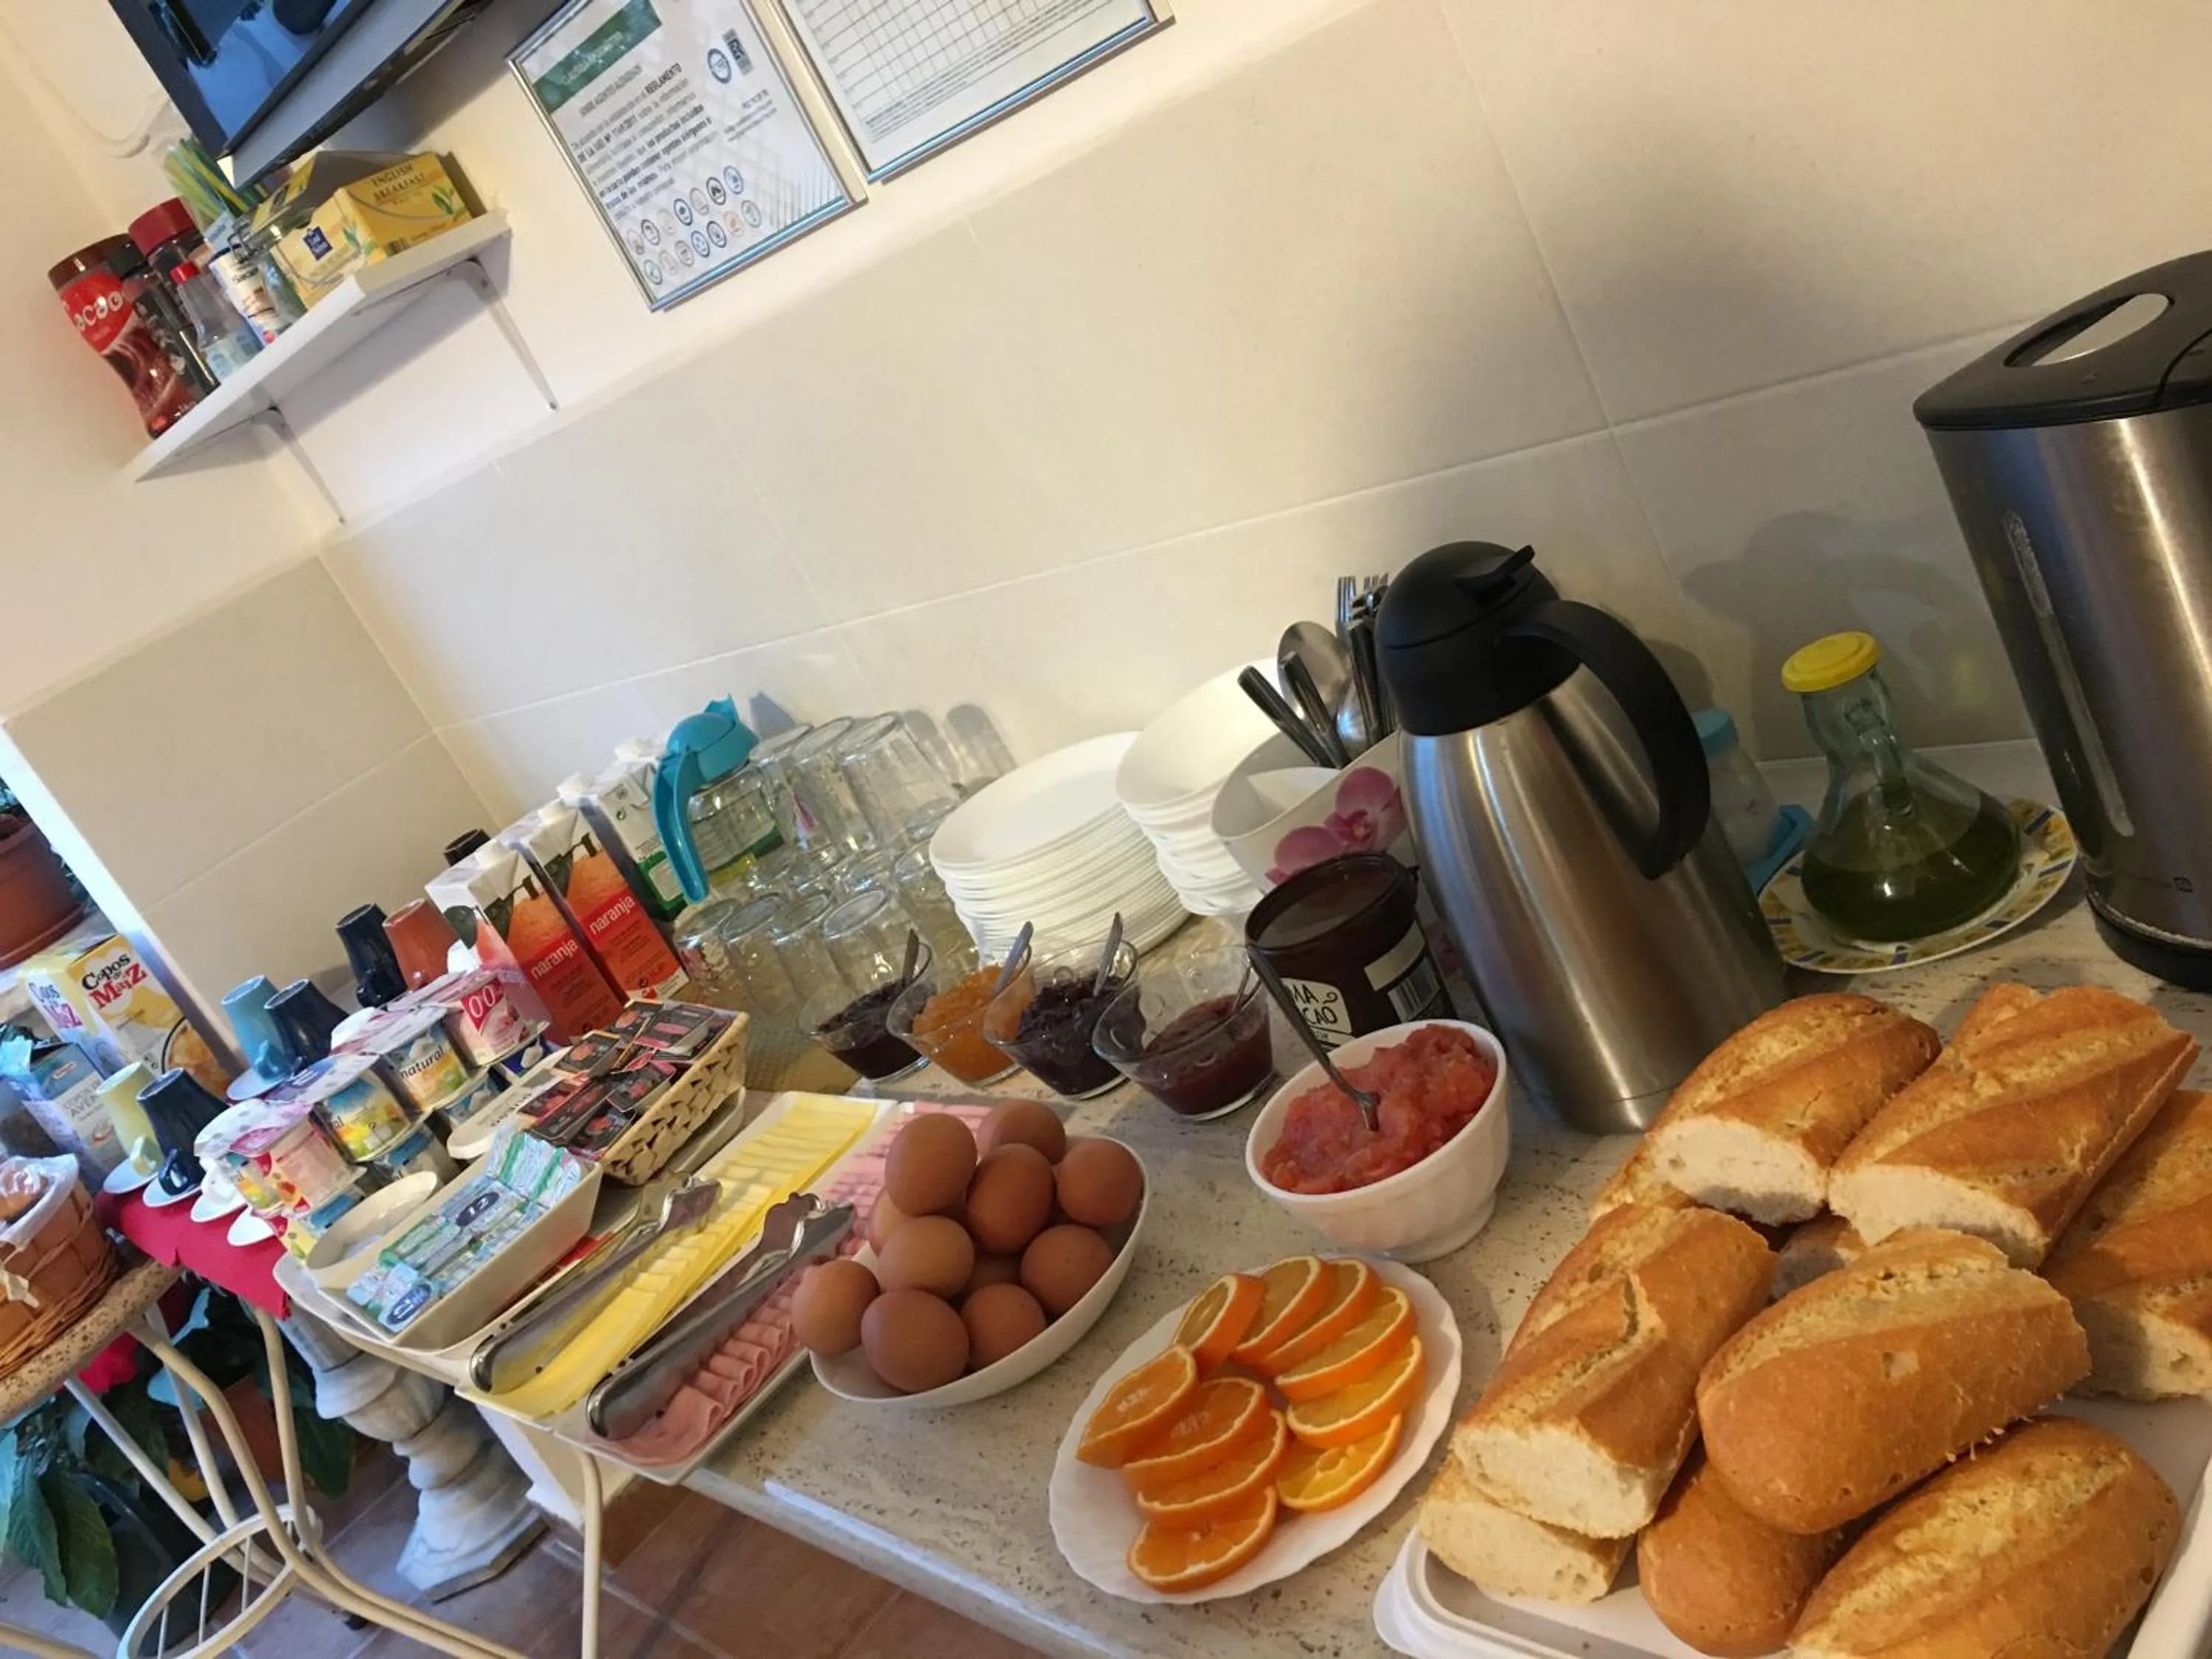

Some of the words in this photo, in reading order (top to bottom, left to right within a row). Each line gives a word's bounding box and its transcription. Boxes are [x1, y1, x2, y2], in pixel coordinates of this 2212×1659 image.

[644, 63, 682, 94] REGLAMENTO
[370, 164, 414, 188] ENGLISH
[373, 173, 425, 203] BREAKFAST
[589, 895, 636, 936] naranja
[82, 953, 131, 990] Copos
[530, 938, 579, 980] naranja
[400, 1044, 445, 1078] natural
